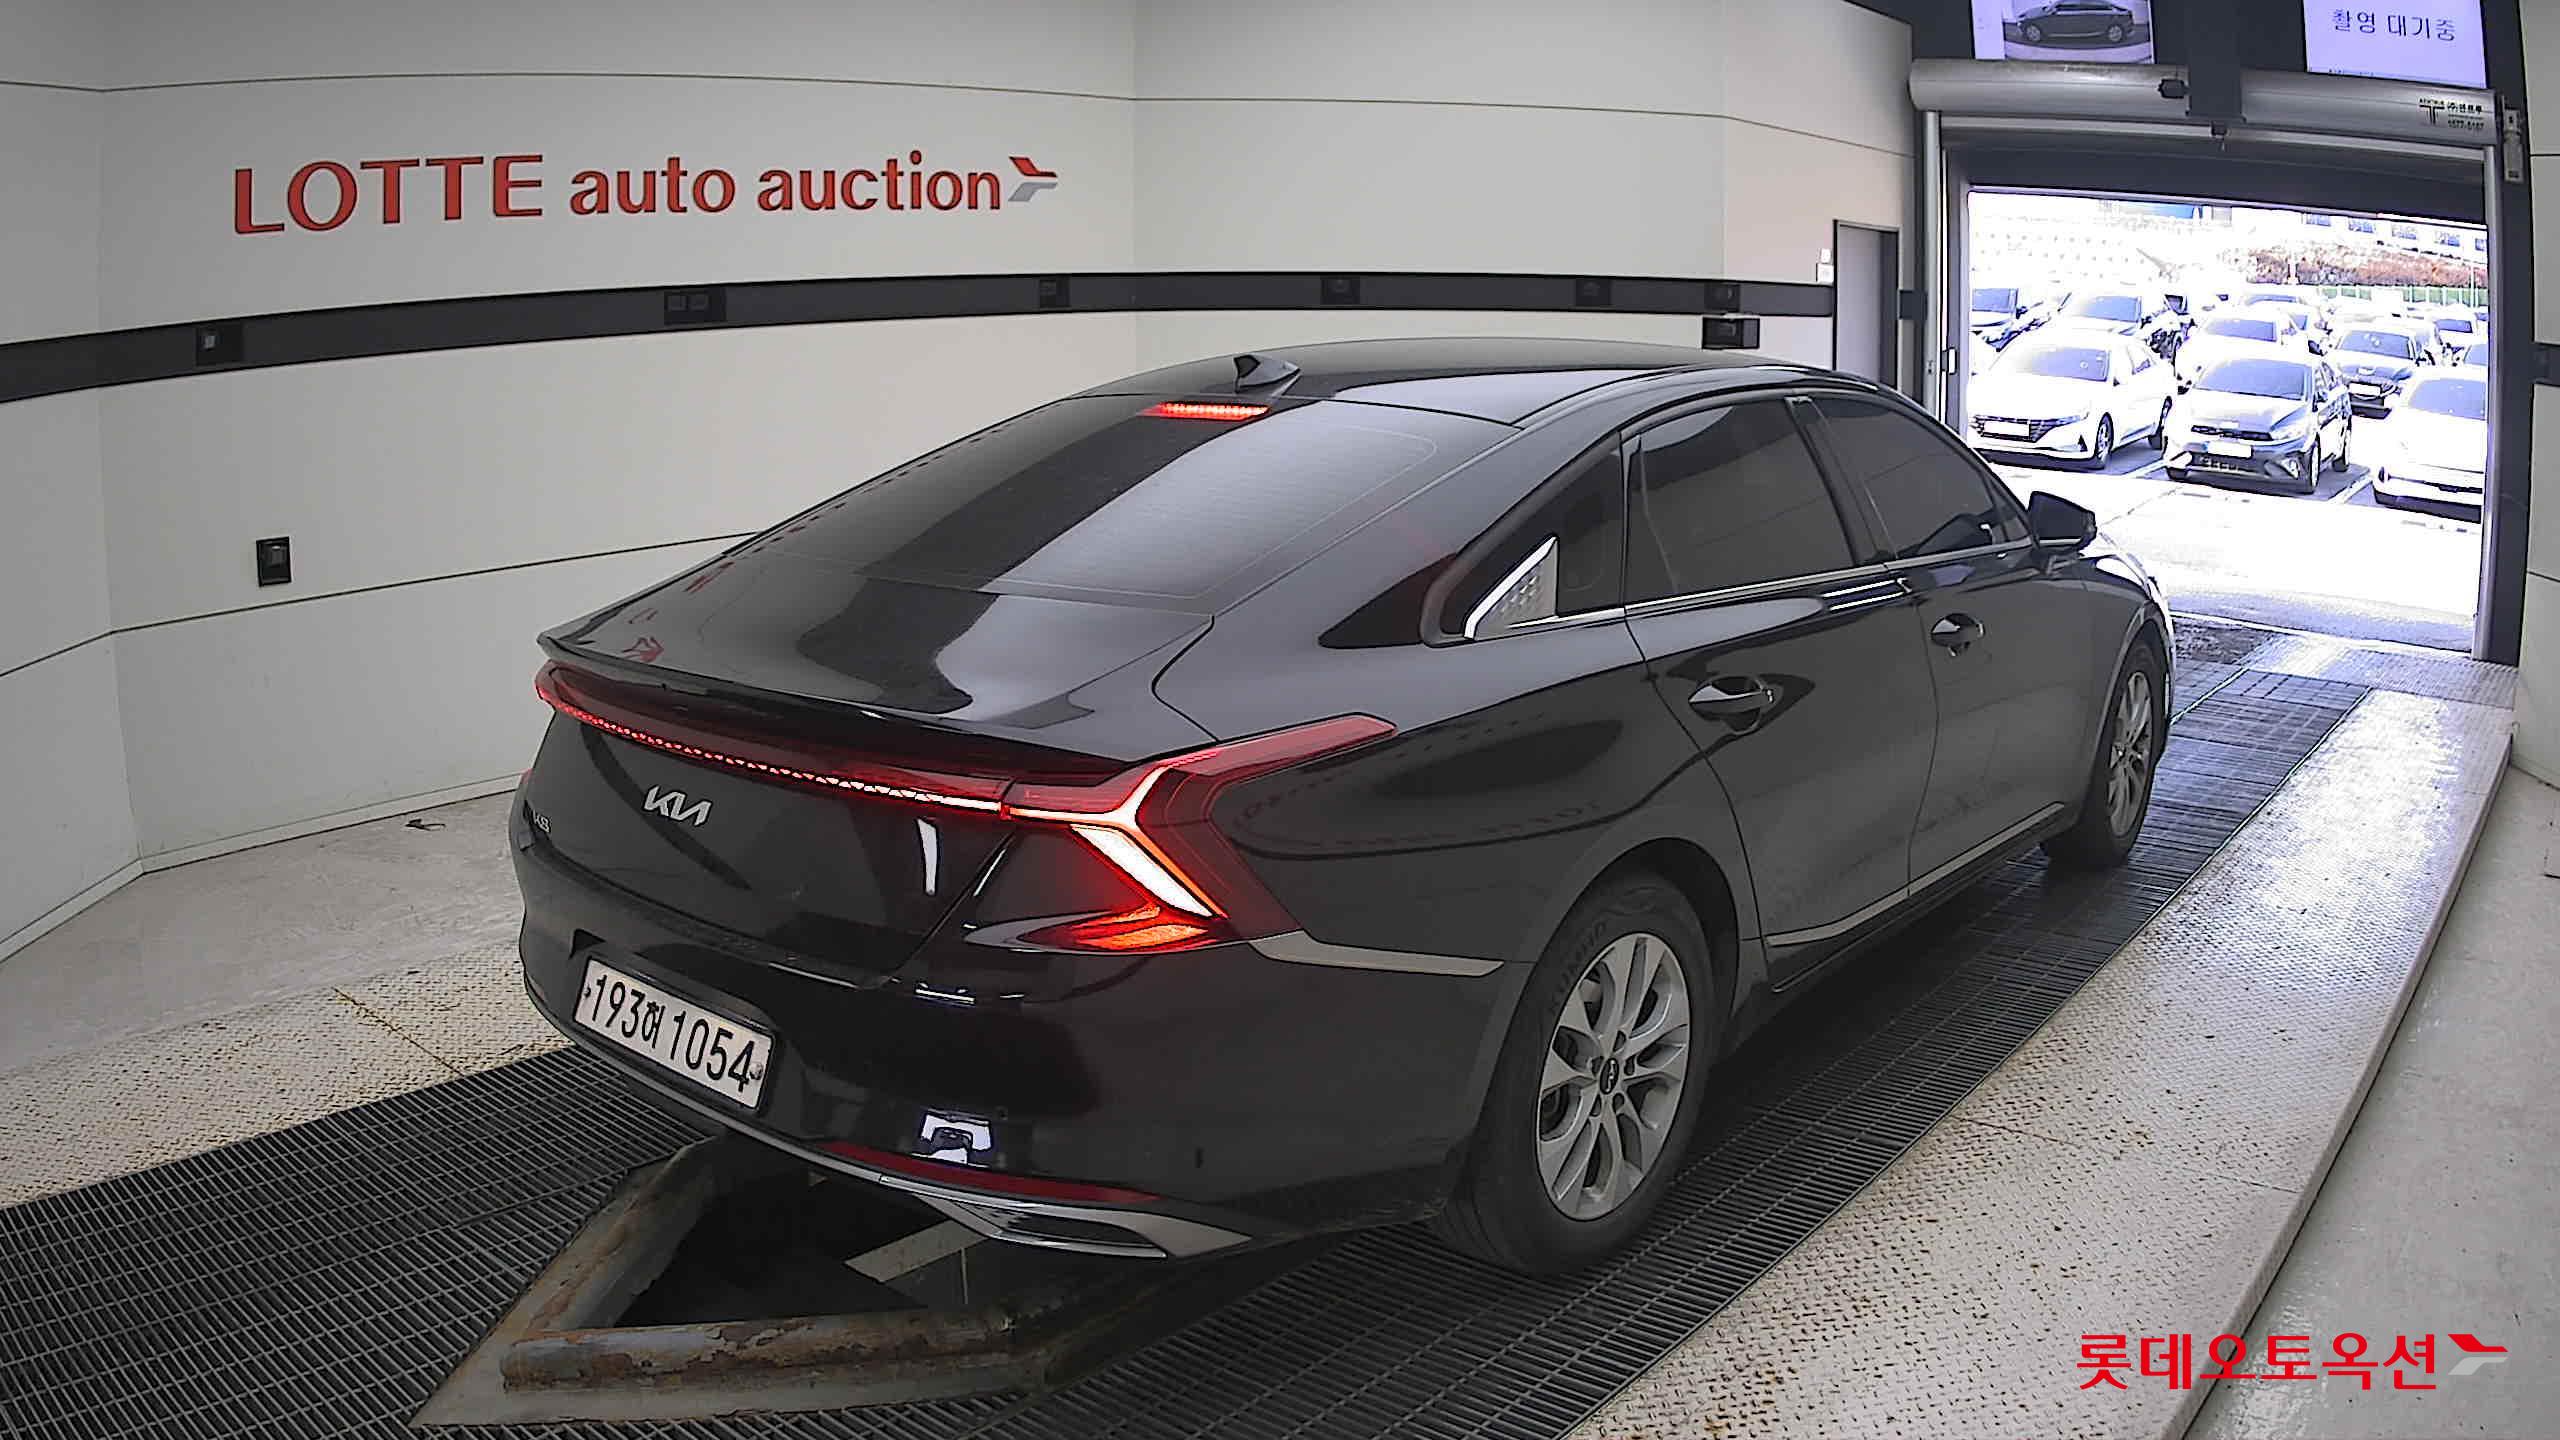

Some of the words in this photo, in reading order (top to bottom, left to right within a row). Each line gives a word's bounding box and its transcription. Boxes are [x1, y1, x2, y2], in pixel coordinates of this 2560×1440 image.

[2333, 9, 2375, 34] 촬영
[2388, 15, 2455, 41] 대기중
[234, 154, 543, 234] LOTTE
[569, 156, 736, 215] auto
[757, 149, 1001, 212] auction
[643, 786, 712, 826] KIA
[591, 974, 666, 1049] 193허
[670, 1010, 755, 1093] 1054
